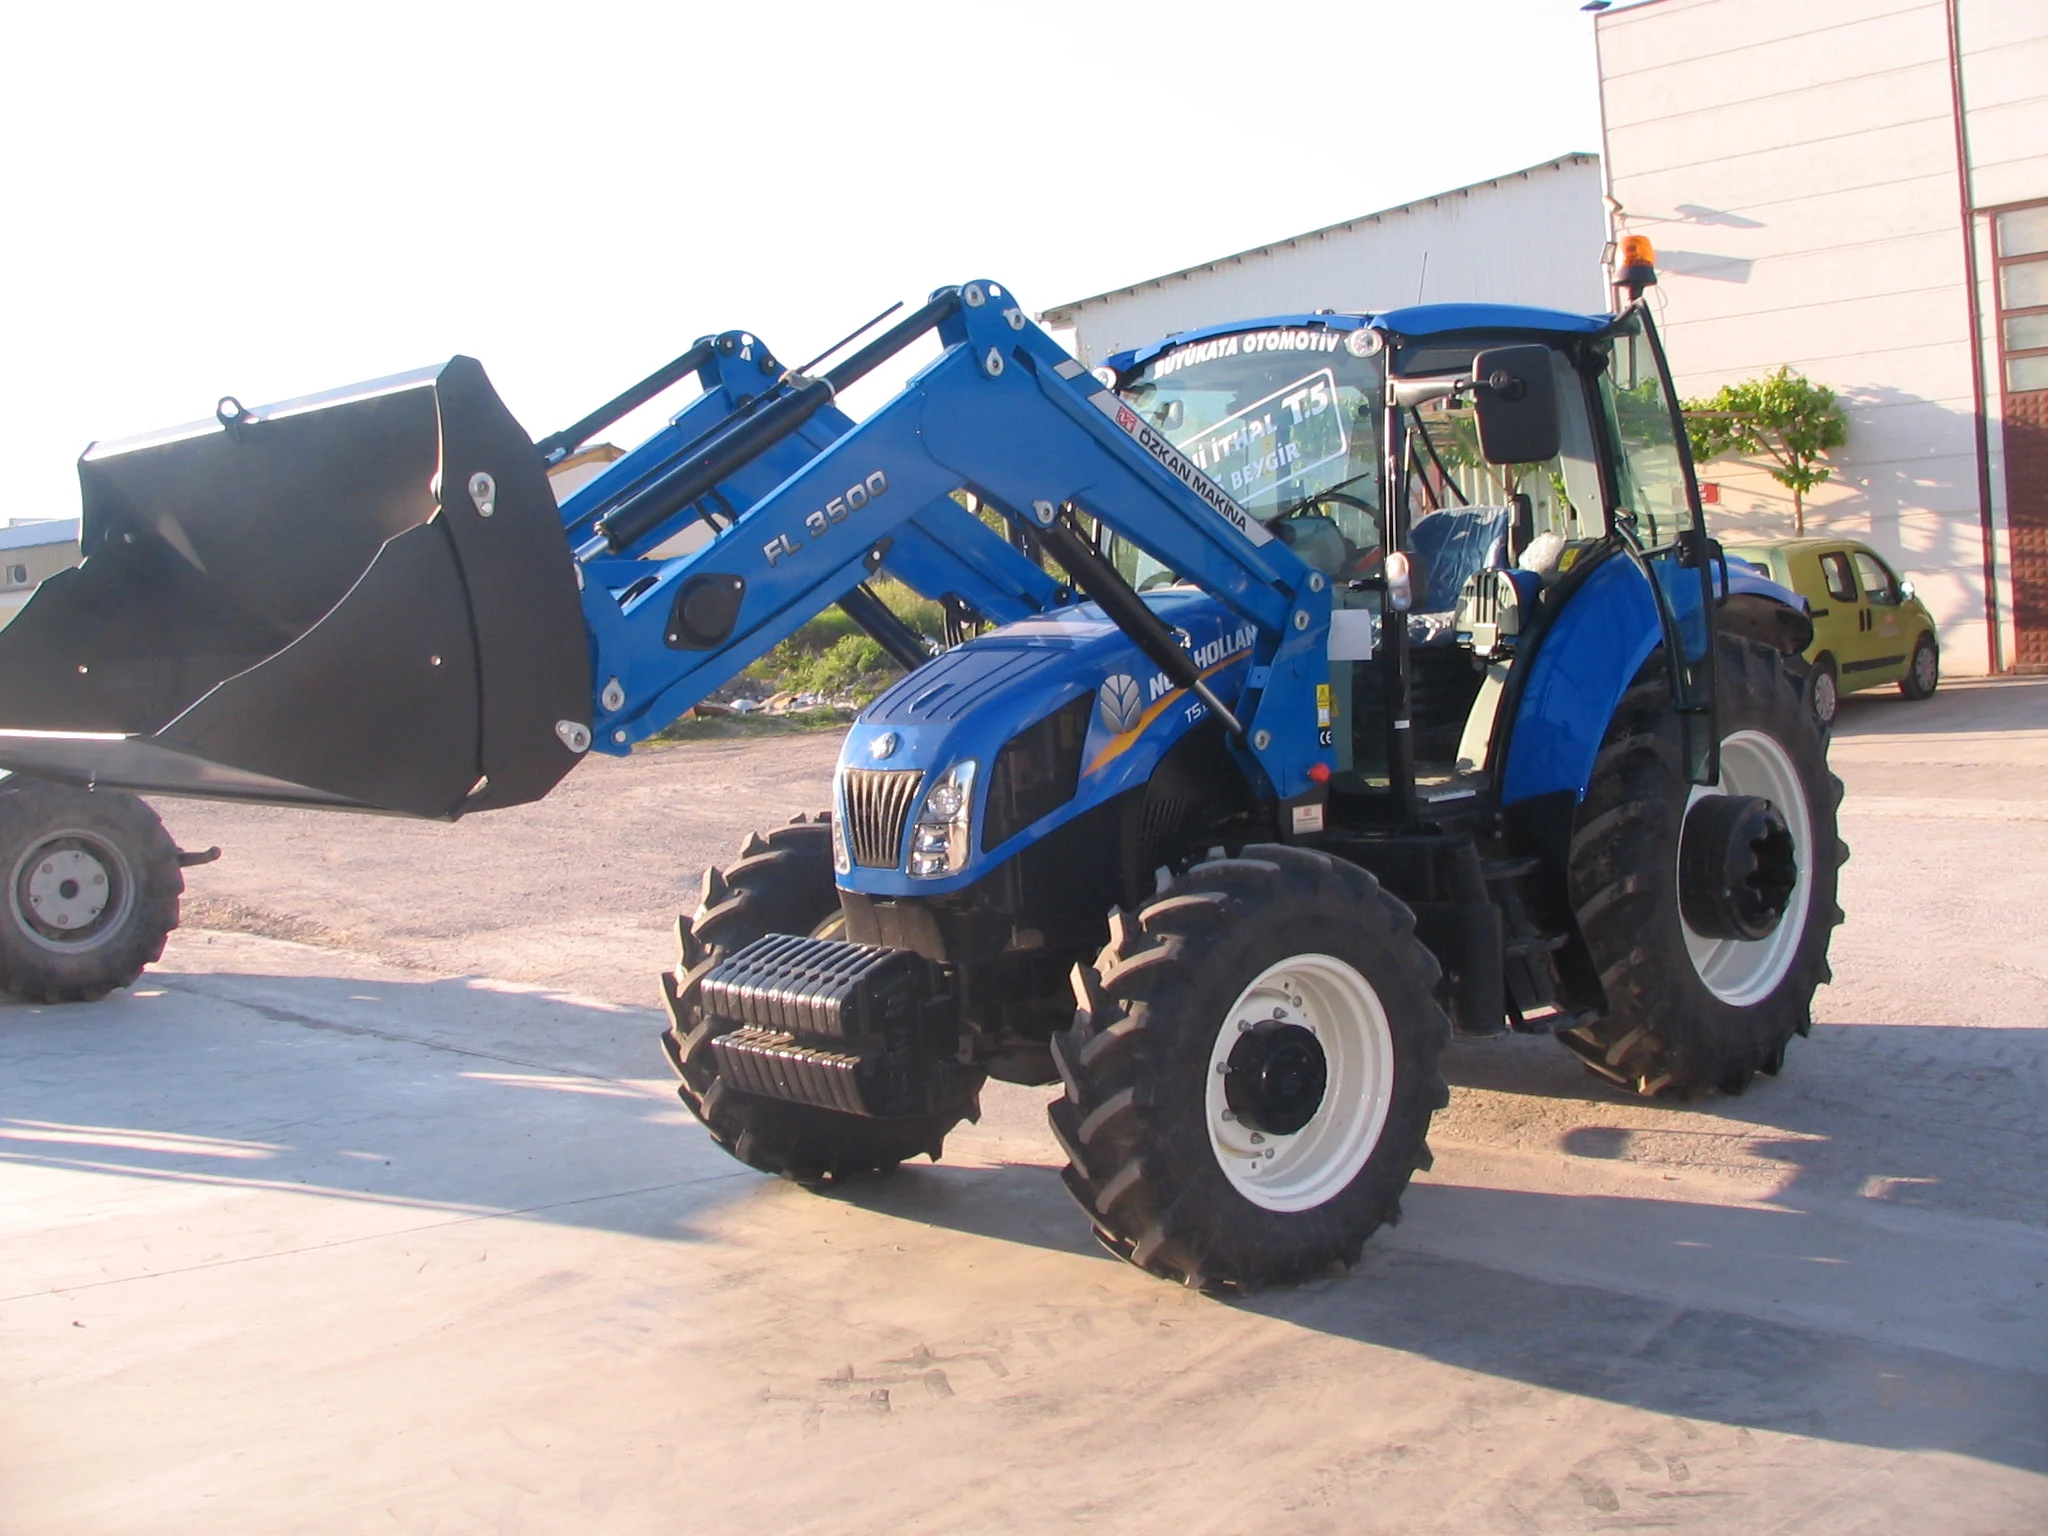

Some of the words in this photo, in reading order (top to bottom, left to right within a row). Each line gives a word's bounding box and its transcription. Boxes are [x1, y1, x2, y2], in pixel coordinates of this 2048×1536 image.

[1243, 328, 1340, 353] OTOMOTİV
[1139, 427, 1191, 481] ÖZKAN
[1192, 476, 1246, 532] MAKİNA
[1230, 442, 1301, 491] BEYGİR
[763, 533, 802, 568] FL
[805, 470, 889, 538] 3500
[1193, 624, 1259, 669] HOLLAN
[1319, 730, 1332, 745] CE
